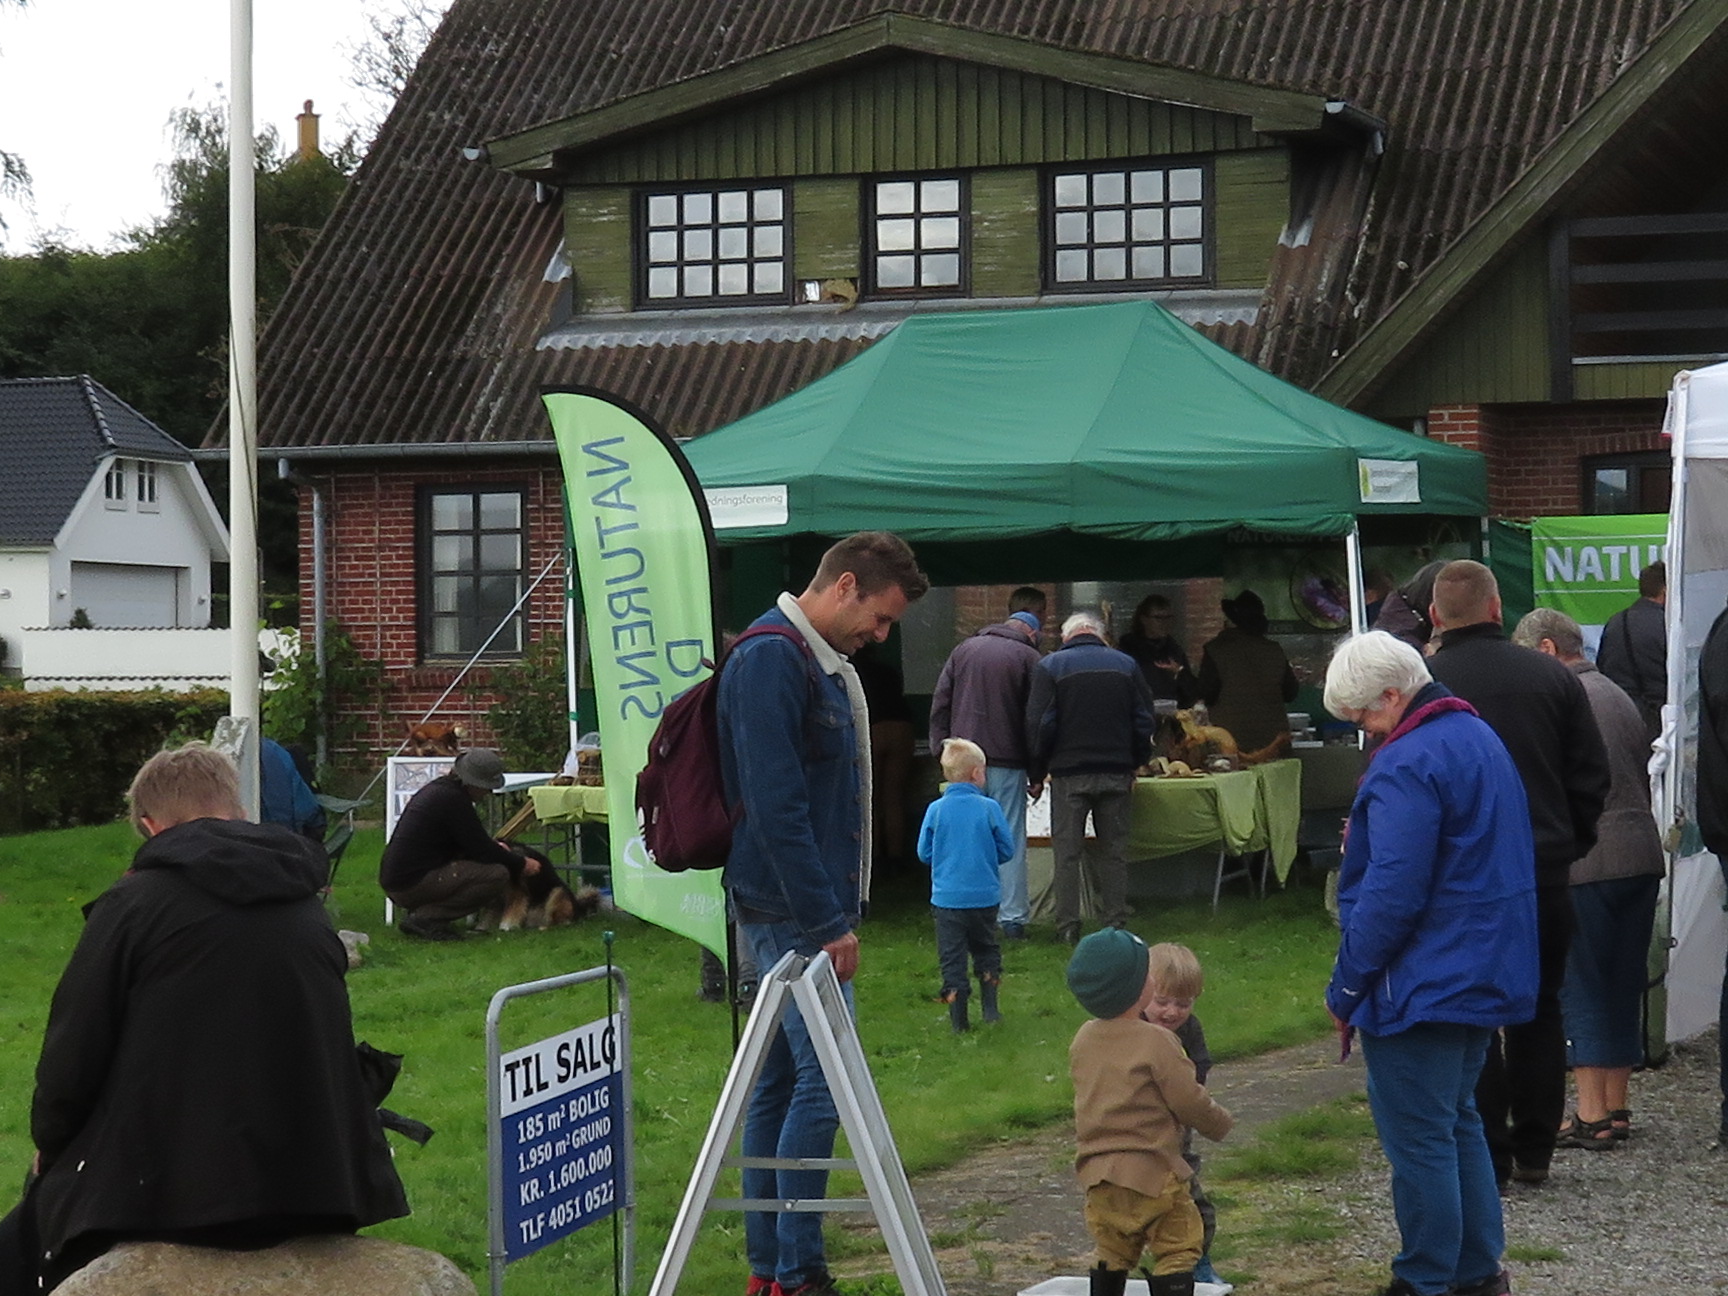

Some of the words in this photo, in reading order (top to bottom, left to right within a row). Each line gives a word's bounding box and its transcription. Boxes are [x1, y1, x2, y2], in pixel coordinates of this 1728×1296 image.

[1545, 544, 1667, 583] NATU
[504, 1052, 549, 1103] TIL
[556, 1025, 616, 1084] SALG
[517, 1112, 544, 1145] 185
[568, 1085, 610, 1123] BOLIG
[517, 1141, 552, 1173] 1.950
[571, 1115, 611, 1149] GRUND
[519, 1177, 545, 1207] KR.
[548, 1144, 613, 1194] 1.600.000
[519, 1212, 545, 1244] TLF
[548, 1195, 582, 1230] 4051
